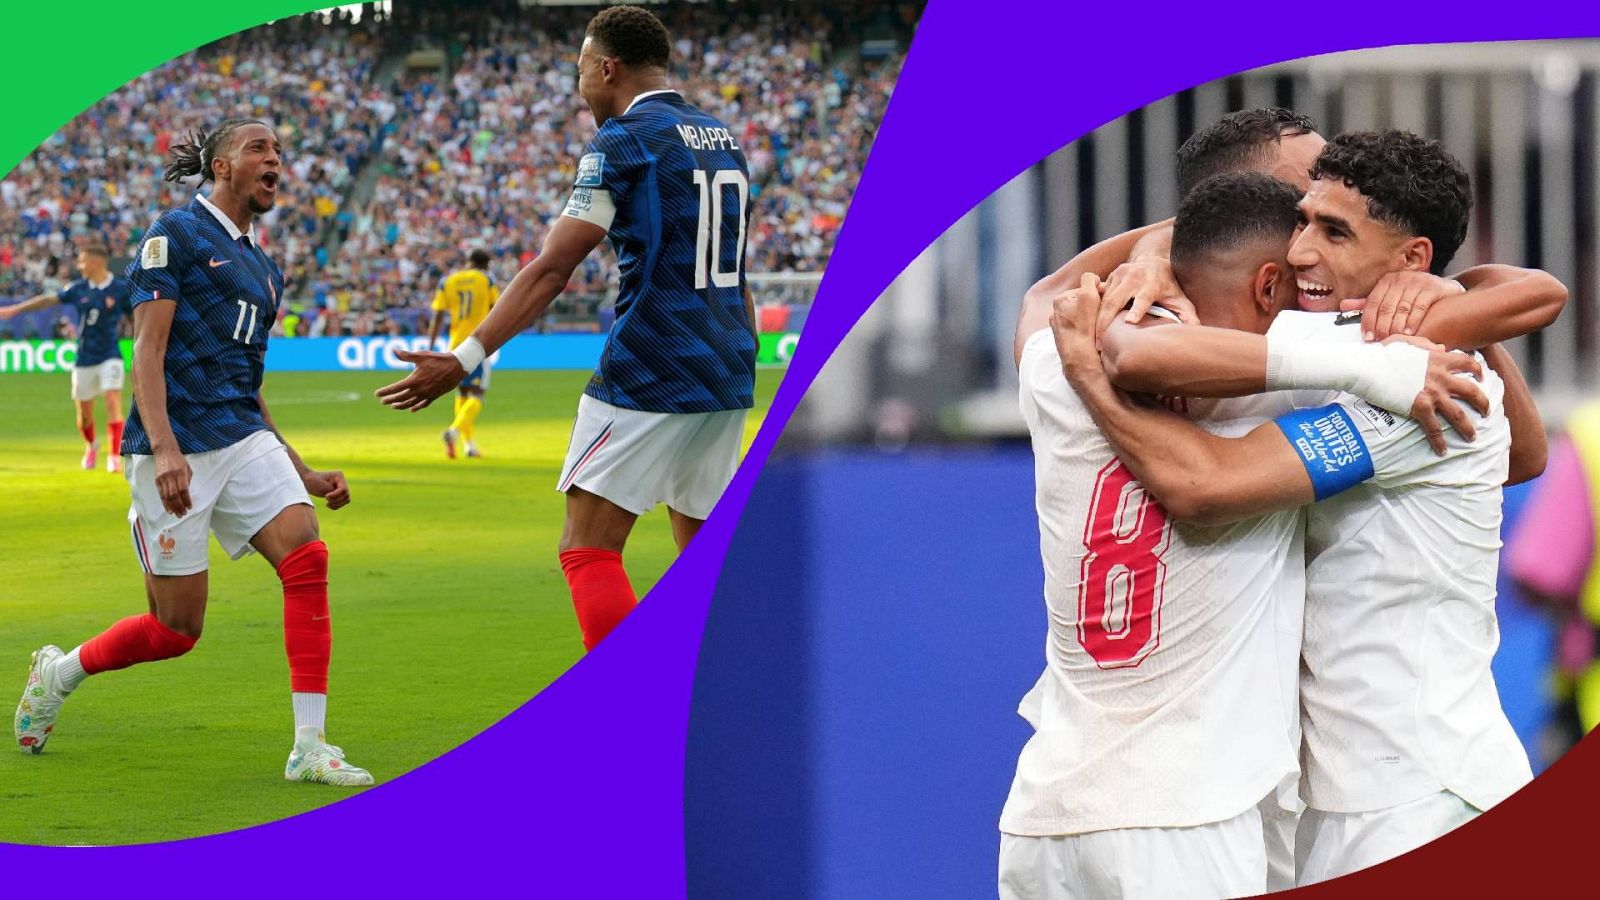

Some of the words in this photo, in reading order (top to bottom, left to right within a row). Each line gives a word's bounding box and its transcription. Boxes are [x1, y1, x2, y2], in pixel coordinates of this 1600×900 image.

[693, 169, 748, 290] 10
[232, 299, 258, 345] 11
[457, 290, 473, 319] 11
[1299, 421, 1315, 438] the
[1310, 437, 1340, 472] World
[1314, 417, 1353, 466] UNITES
[1328, 411, 1363, 461] FOOTBALL
[1076, 456, 1173, 670] 8
